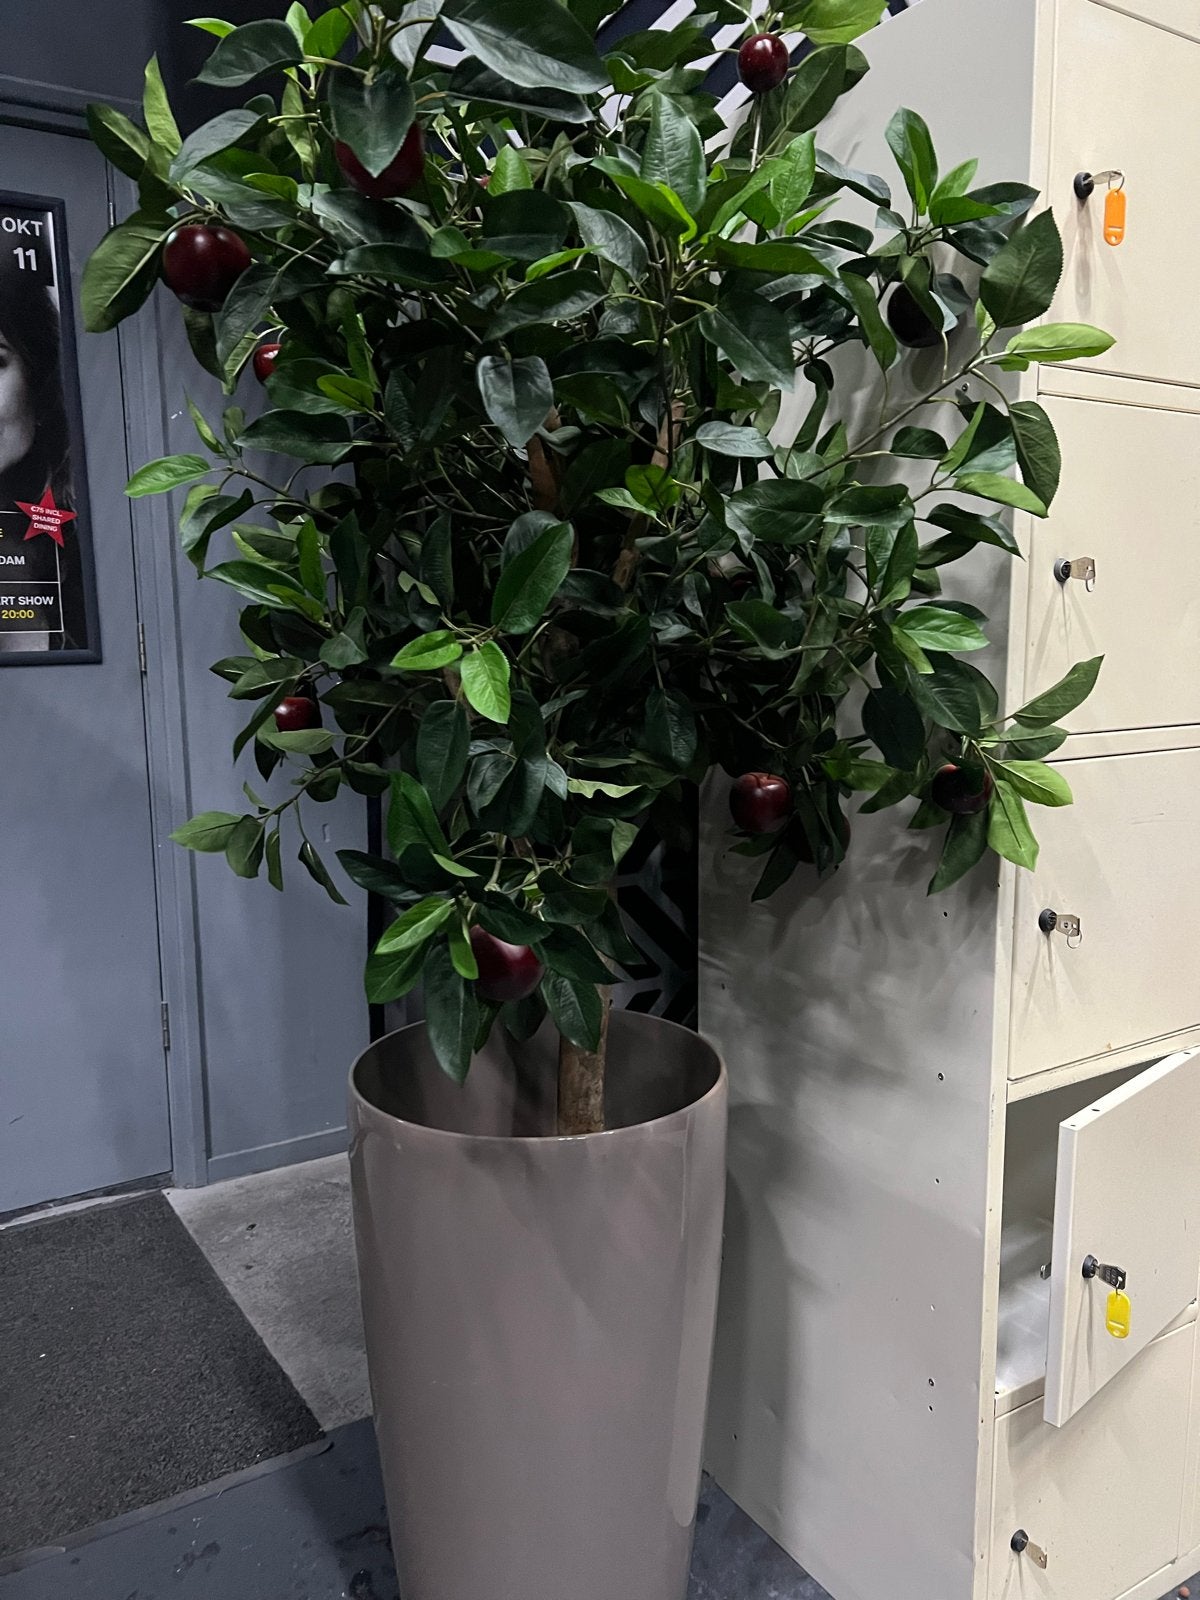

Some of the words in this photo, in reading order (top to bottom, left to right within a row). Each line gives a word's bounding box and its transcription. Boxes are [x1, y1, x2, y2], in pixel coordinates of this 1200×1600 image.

[1, 216, 43, 237] OKT
[13, 247, 37, 271] 11
[32, 514, 61, 525] SHARED
[33, 522, 58, 532] DINING
[0, 596, 16, 606] RT
[17, 595, 54, 606] SHOW
[1, 609, 35, 619] 20:00
